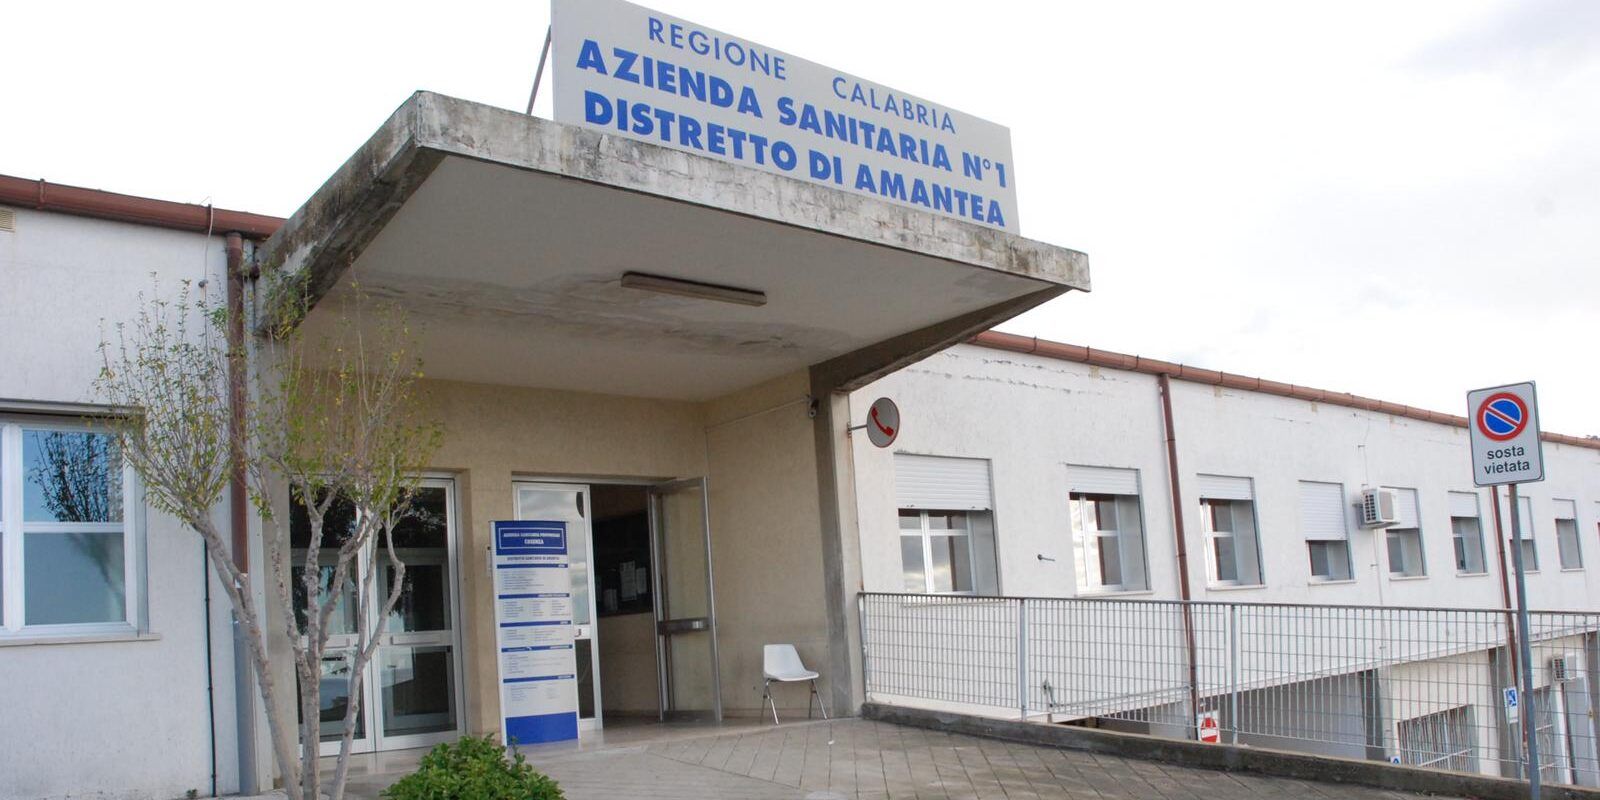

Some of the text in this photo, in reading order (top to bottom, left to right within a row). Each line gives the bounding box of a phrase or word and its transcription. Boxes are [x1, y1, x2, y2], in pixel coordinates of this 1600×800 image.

[576, 39, 763, 119] AZIENDA
[777, 97, 952, 172] SANITARIA
[648, 17, 956, 134] REGIONE CALABRIA
[584, 90, 1005, 227] DISTRETTO DI AMANTEA
[1484, 460, 1530, 475] vietata
[1487, 446, 1525, 460] sosta
